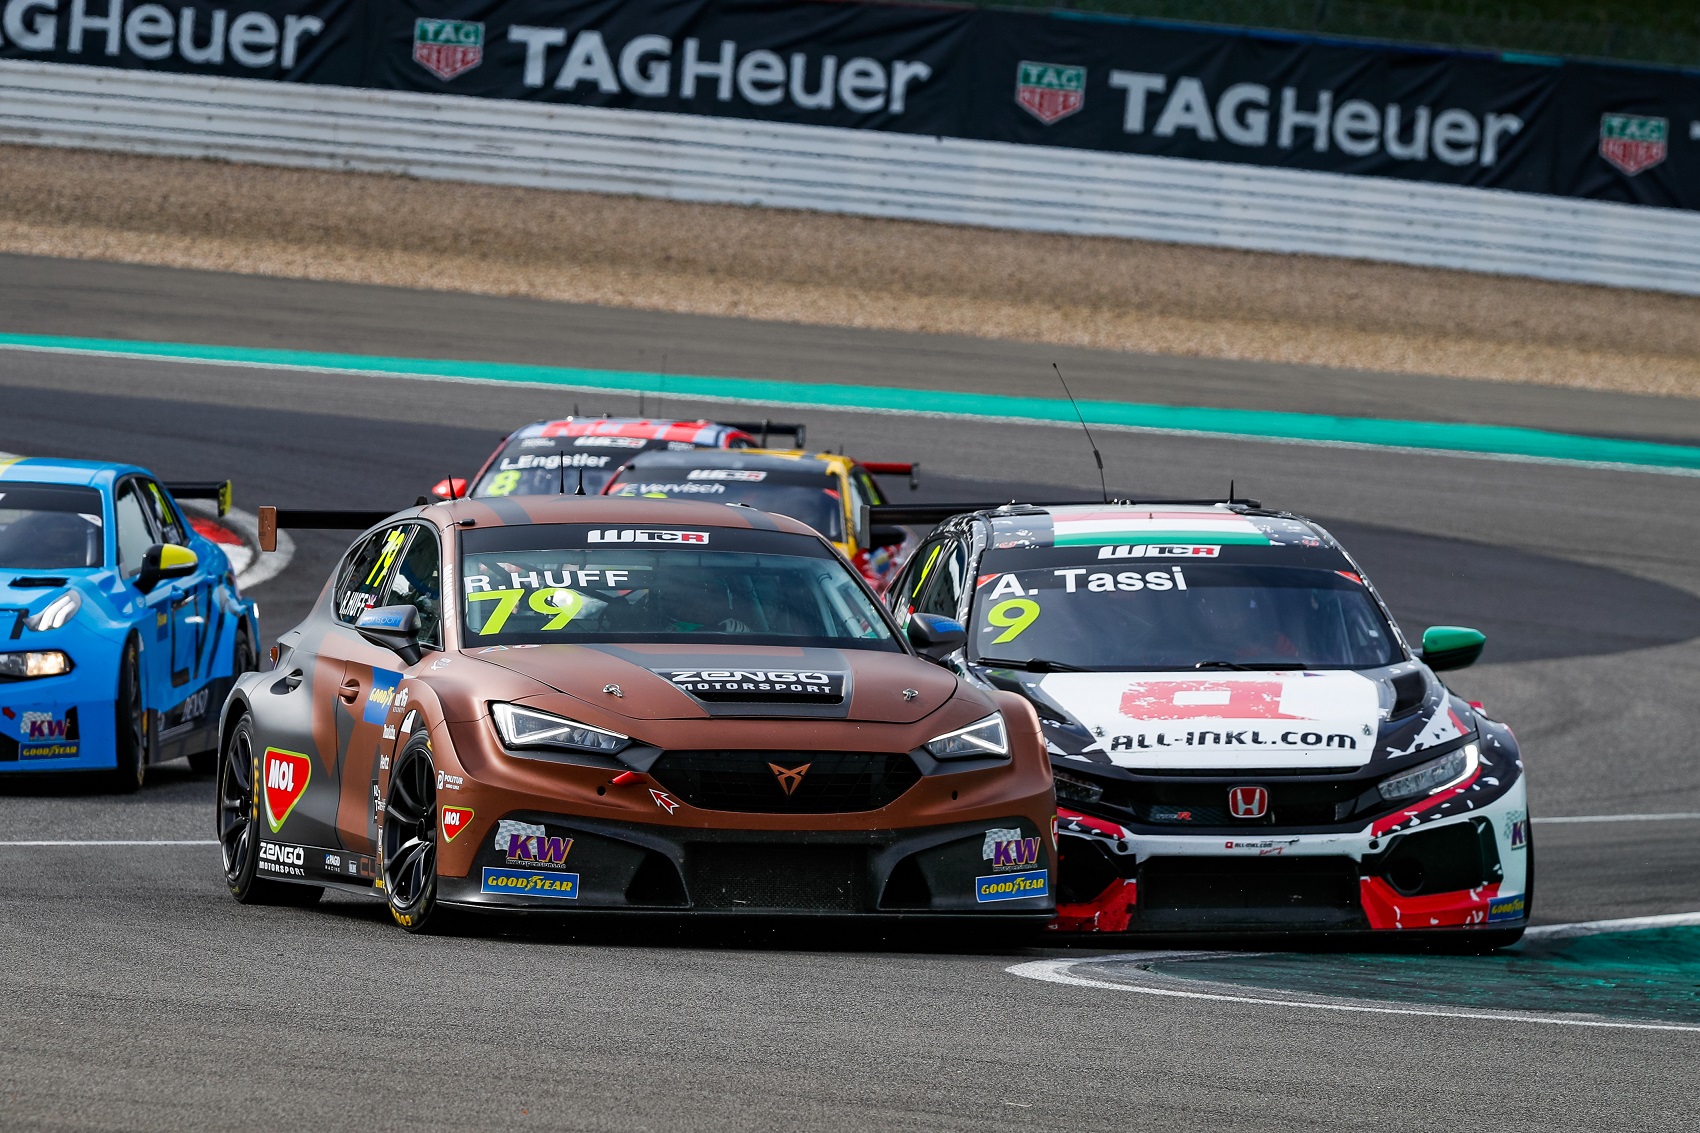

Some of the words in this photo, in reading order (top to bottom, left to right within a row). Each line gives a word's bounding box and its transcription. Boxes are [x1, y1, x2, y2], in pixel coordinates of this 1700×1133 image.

[424, 22, 477, 43] TAG
[1026, 66, 1079, 88] TAG
[487, 470, 522, 497] 8
[587, 529, 711, 545] WTCR
[365, 530, 406, 588] 79
[1098, 544, 1222, 560] WTCR
[463, 570, 629, 593] R.HUFF
[988, 573, 1039, 601] A.
[1053, 566, 1188, 594] Tassi
[467, 587, 584, 637] 79
[987, 598, 1041, 645] 9
[676, 682, 832, 694] MOTORSPORT
[29, 718, 71, 740] KW
[268, 758, 295, 792] MOL
[444, 810, 460, 826] MOL
[1511, 820, 1527, 847] K
[506, 833, 575, 864] KW
[992, 836, 1042, 867] KW
[259, 860, 306, 876] MOTORSPORT
[487, 875, 573, 891] GOODYEAR
[980, 876, 1045, 895] GOODYEAR
